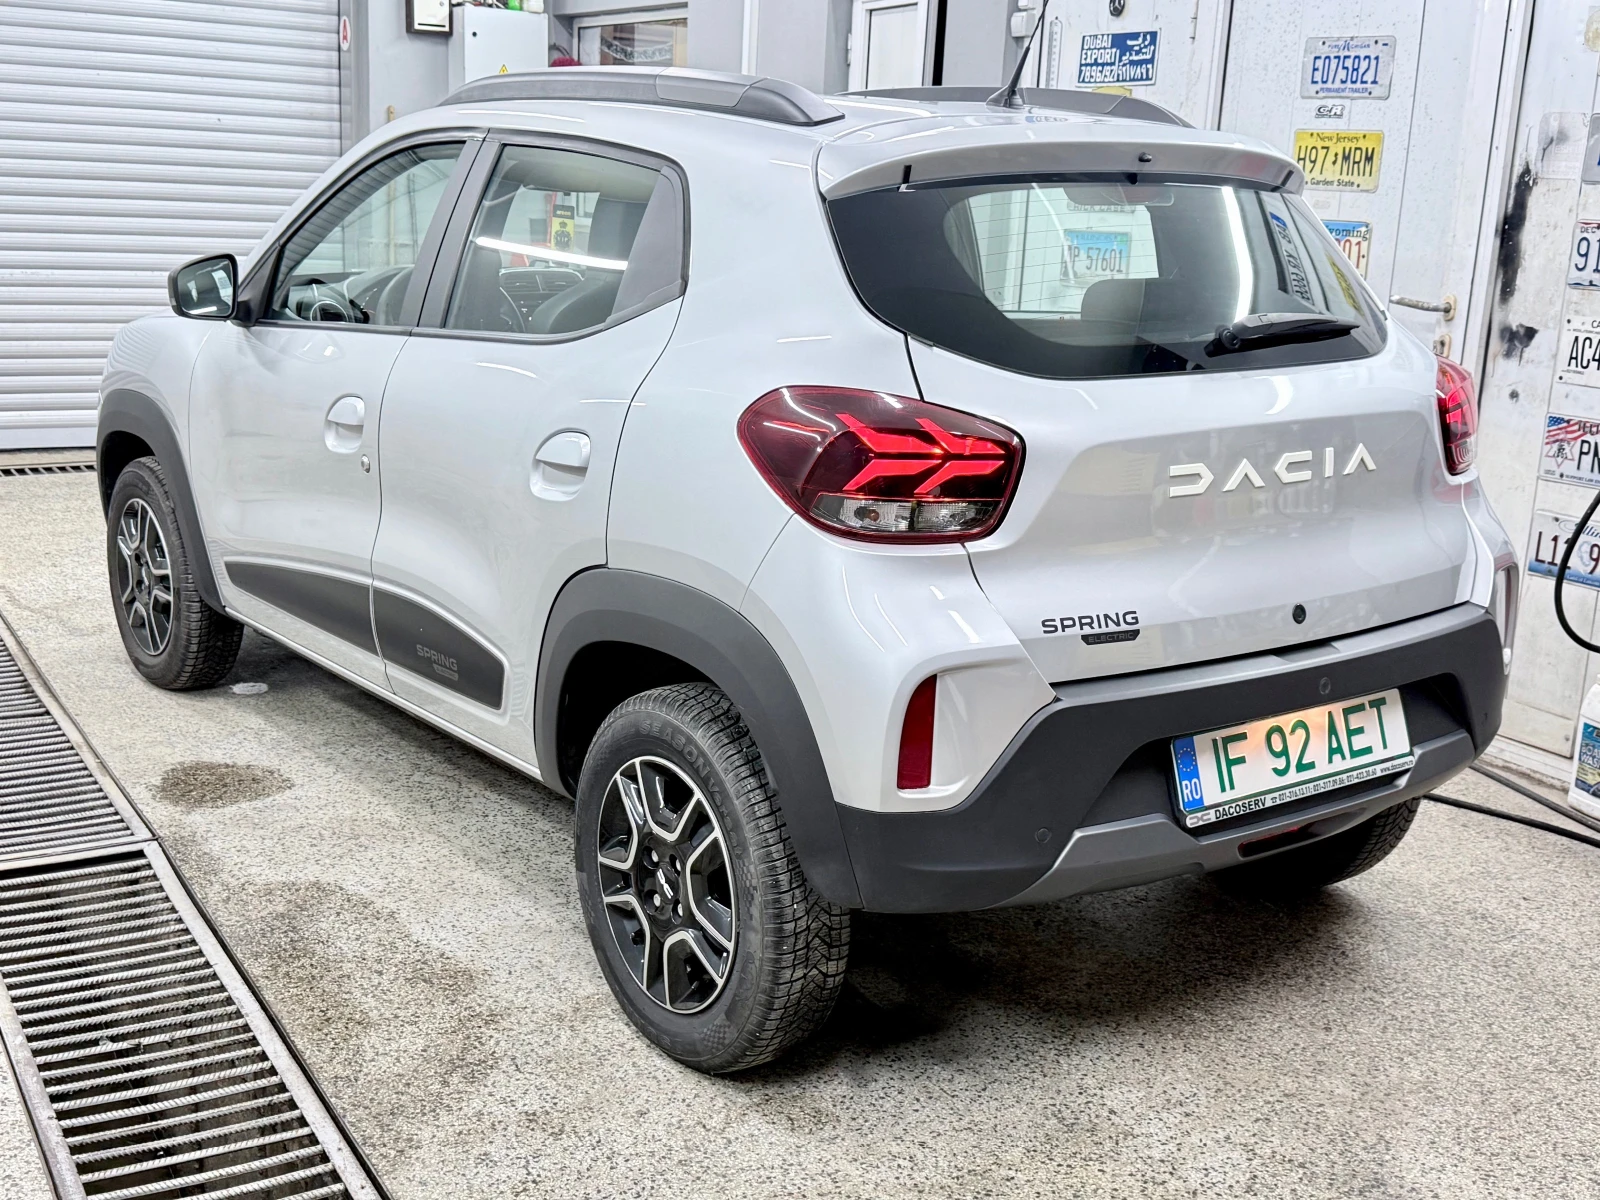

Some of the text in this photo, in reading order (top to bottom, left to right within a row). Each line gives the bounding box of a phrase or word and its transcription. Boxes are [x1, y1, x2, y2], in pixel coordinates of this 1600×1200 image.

[342, 19, 348, 44] A
[1083, 35, 1112, 49] DUBAI
[1081, 48, 1117, 64] EXPORT
[1080, 65, 1117, 82] 7896/92
[1311, 55, 1380, 84] E075821
[1315, 132, 1361, 145] New Jersey
[1296, 146, 1376, 177] H97 MRM
[1310, 178, 1356, 188] Garden State
[1325, 223, 1369, 241] yoming
[1580, 226, 1596, 234] DEC
[1086, 246, 1124, 273] 57601
[1169, 442, 1377, 498] DACIA
[1041, 610, 1139, 634] SPRING
[1088, 632, 1135, 643] ELECTRIC
[416, 644, 457, 671] SPRING
[640, 719, 710, 777] SEASON
[1212, 697, 1387, 793] IF 92 AET
[1182, 778, 1201, 802] RO
[1214, 797, 1267, 819] DACOSERV
